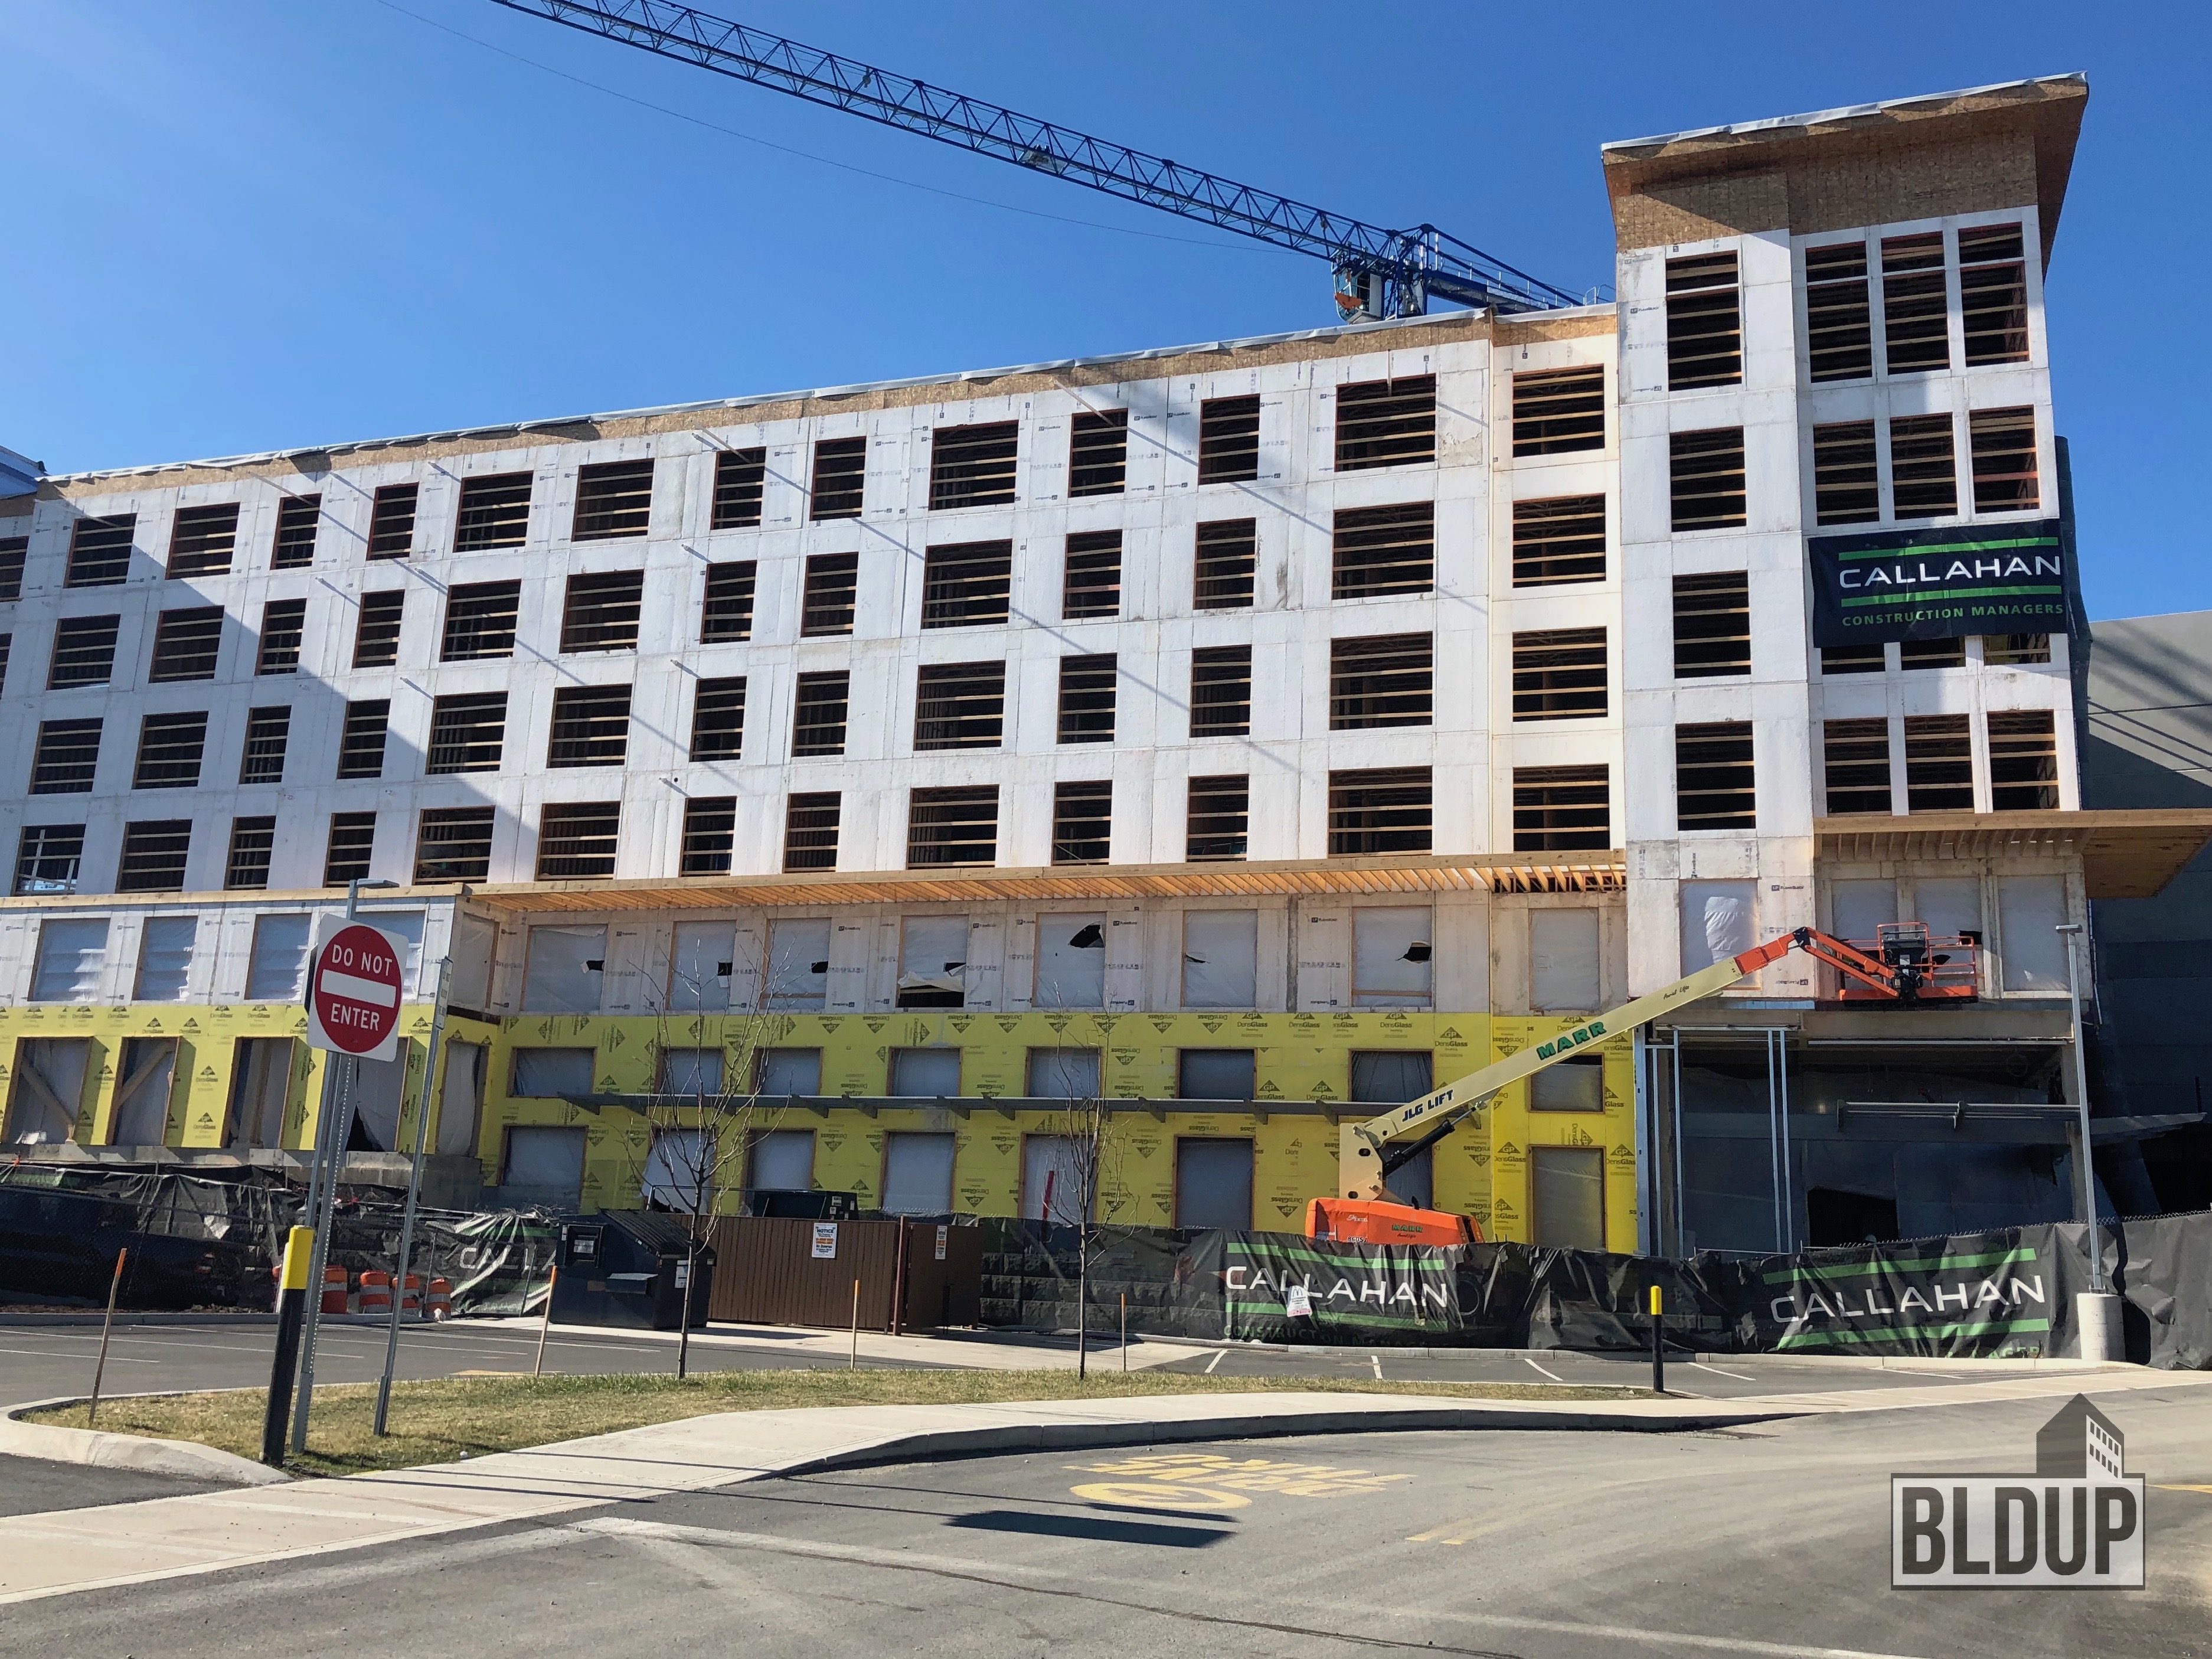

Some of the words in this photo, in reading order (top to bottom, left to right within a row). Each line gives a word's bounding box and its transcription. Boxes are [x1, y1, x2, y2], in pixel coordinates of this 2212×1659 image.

[1839, 556, 2061, 589] CALLAHAN
[1842, 607, 1964, 626] CONSTRUCTION
[1972, 603, 2064, 617] MANAGERS
[332, 944, 353, 966] DO
[361, 952, 393, 977] NOT
[331, 1002, 380, 1031] ENTER
[1536, 1021, 1607, 1060] MARR
[1401, 1102, 1424, 1122] JLG
[1428, 1089, 1455, 1110] LIFT
[1391, 1224, 1423, 1233] MARR
[1226, 1266, 1448, 1308] CALLAHAN
[1770, 1275, 2046, 1324] CALLAHAN
